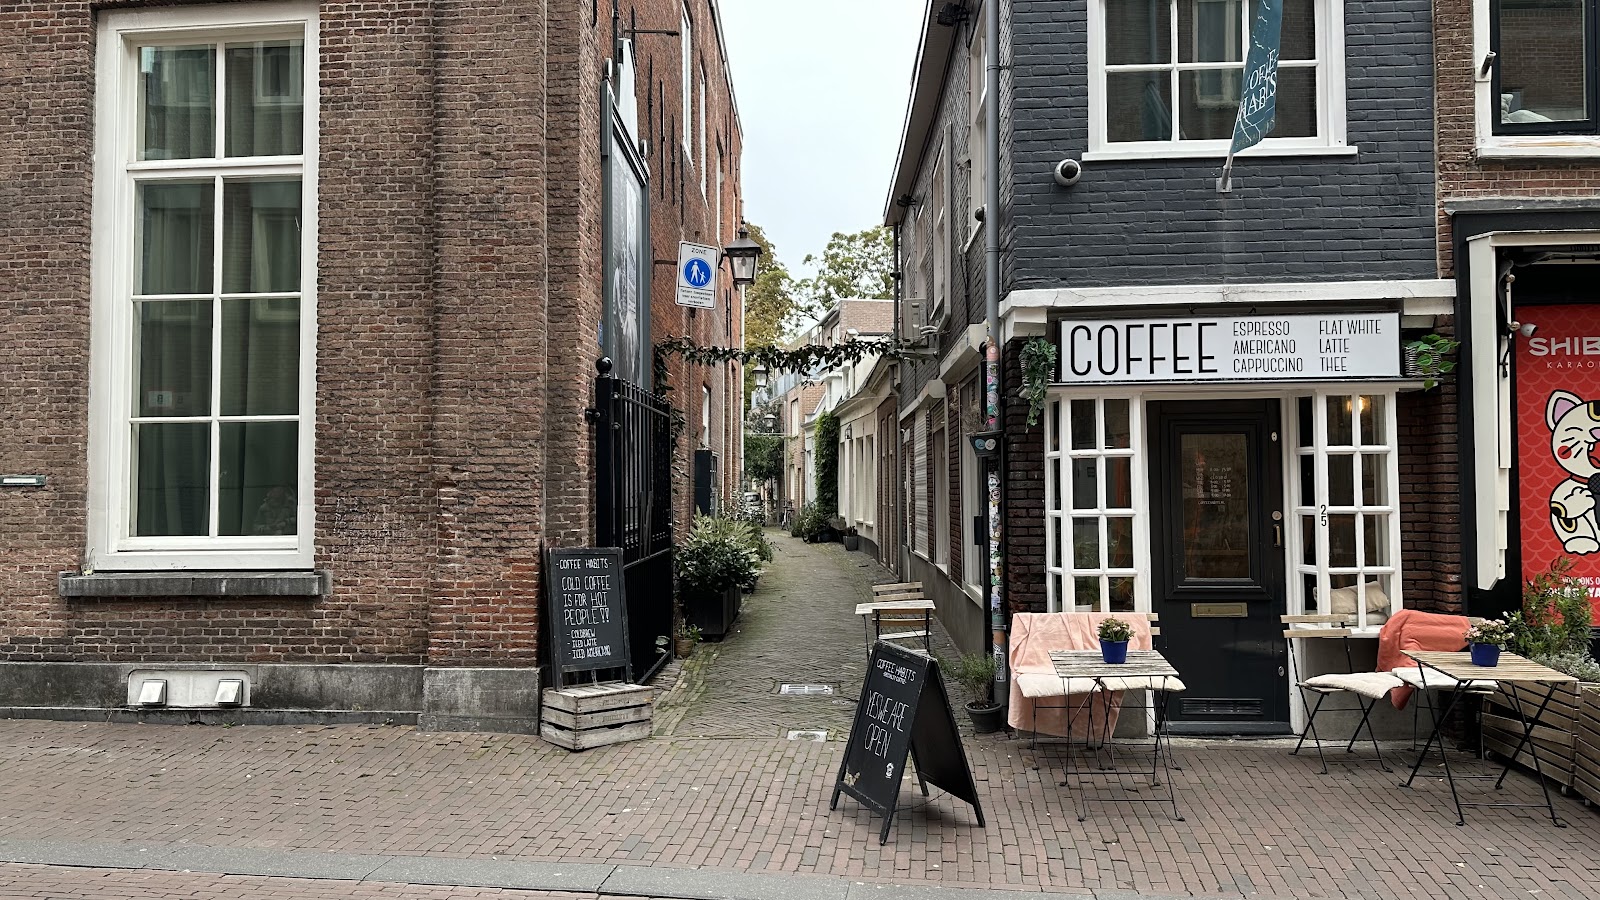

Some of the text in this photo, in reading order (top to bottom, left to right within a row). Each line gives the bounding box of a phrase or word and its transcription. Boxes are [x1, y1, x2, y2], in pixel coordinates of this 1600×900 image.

[1233, 320, 1290, 336] ESPRESSO
[1319, 319, 1381, 335] FLAT WHITE
[1070, 322, 1218, 376] COFFEE
[1233, 339, 1296, 355] AMERICANO
[1319, 338, 1350, 354] LATTE
[1233, 357, 1303, 373] CAPPUCCINO
[1320, 356, 1347, 372] THEE
[1547, 361, 1600, 369] KARAO
[562, 575, 611, 591] COLD COFFEE
[563, 592, 607, 607] IS FOR HOT
[877, 659, 916, 682] COFFEE HABITS
[887, 701, 909, 732] ARE
[865, 723, 892, 759] OPEN
